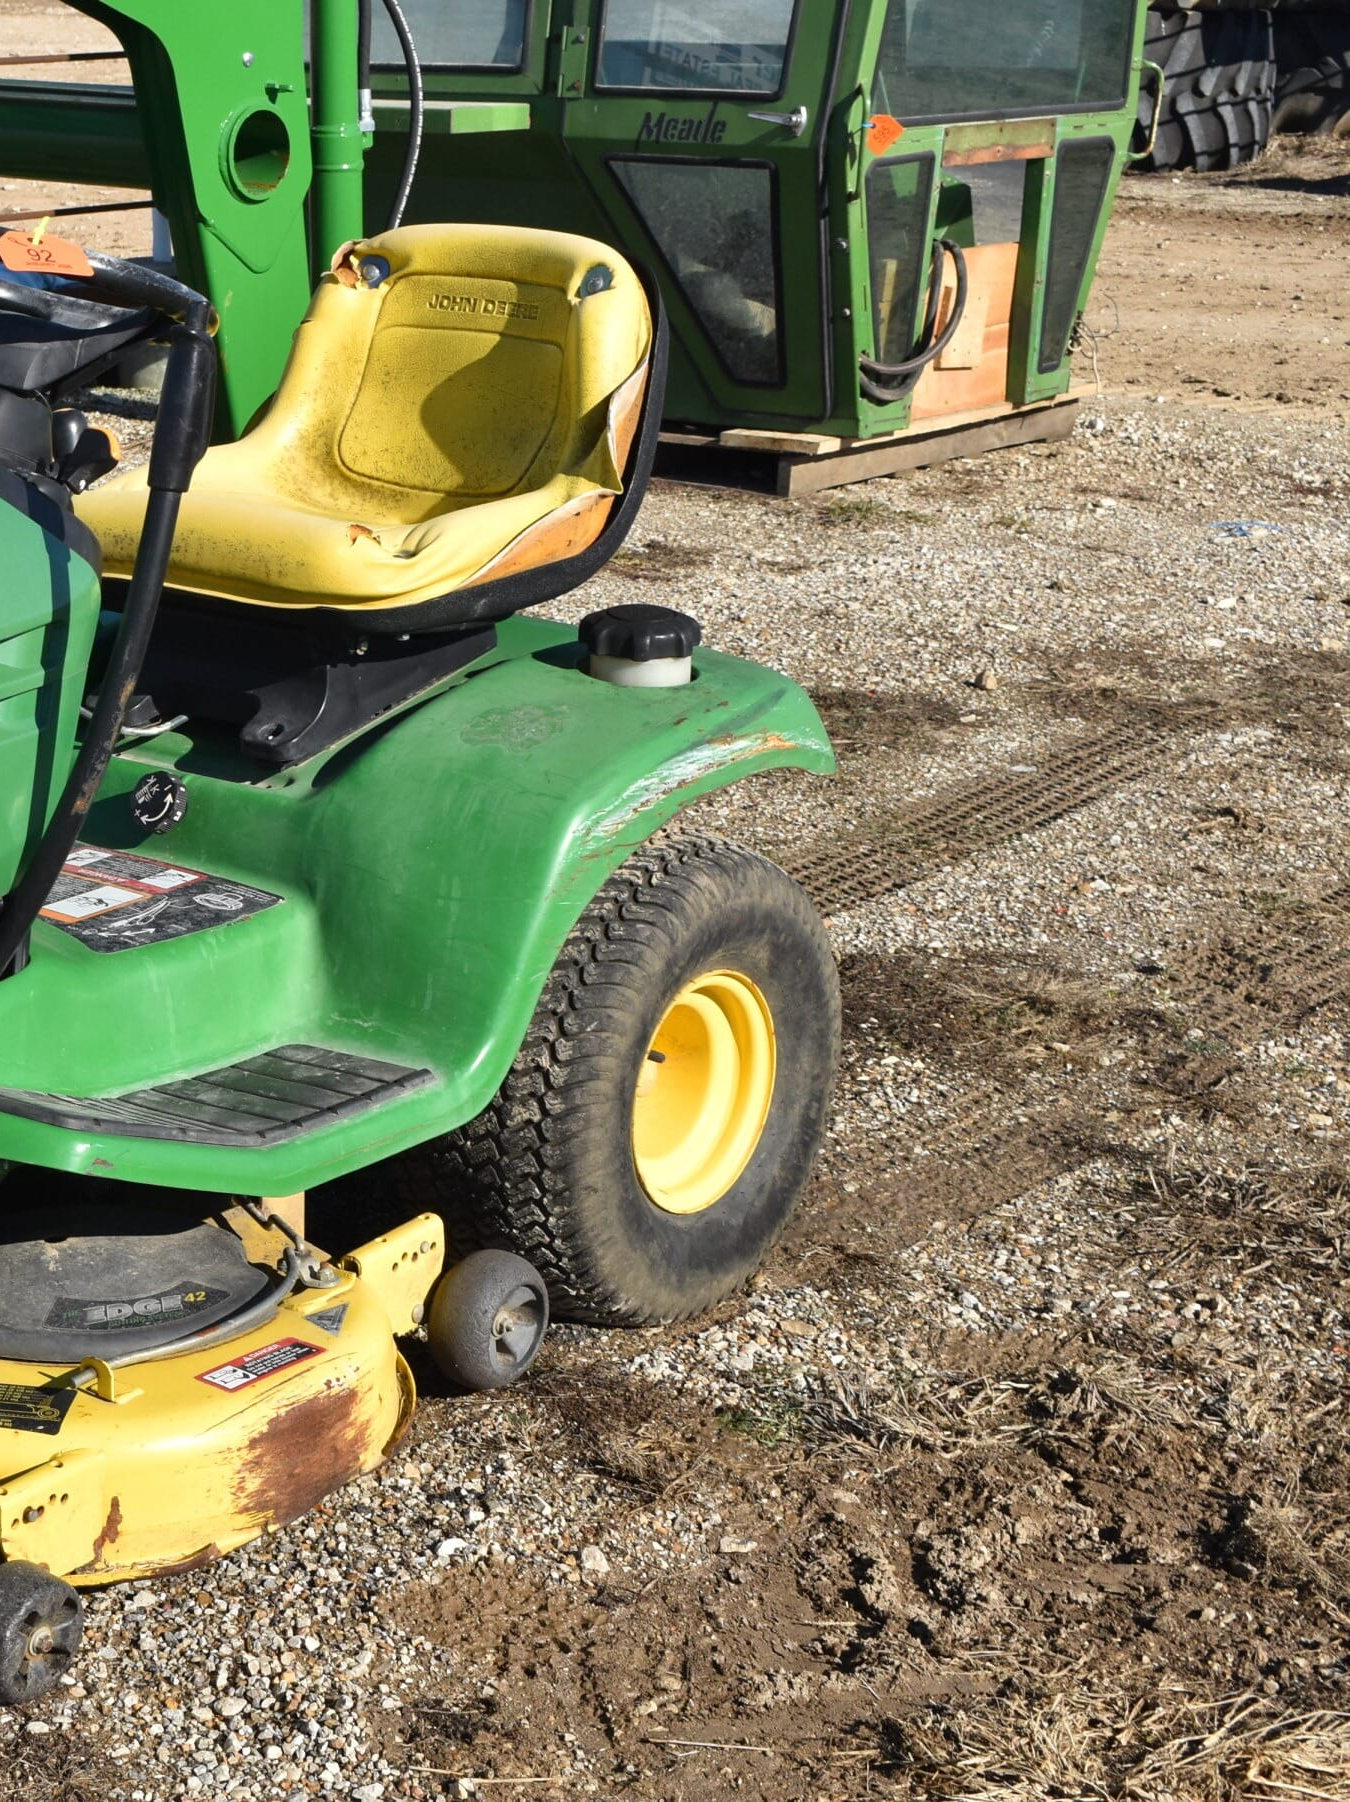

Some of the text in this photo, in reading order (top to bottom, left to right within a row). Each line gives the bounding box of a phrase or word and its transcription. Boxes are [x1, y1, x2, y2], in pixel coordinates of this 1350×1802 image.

[636, 102, 727, 152] Meade
[26, 248, 56, 263] 92
[427, 294, 539, 320] JOHN DEERE
[83, 1294, 185, 1326] EDGE
[185, 1291, 207, 1303] 42
